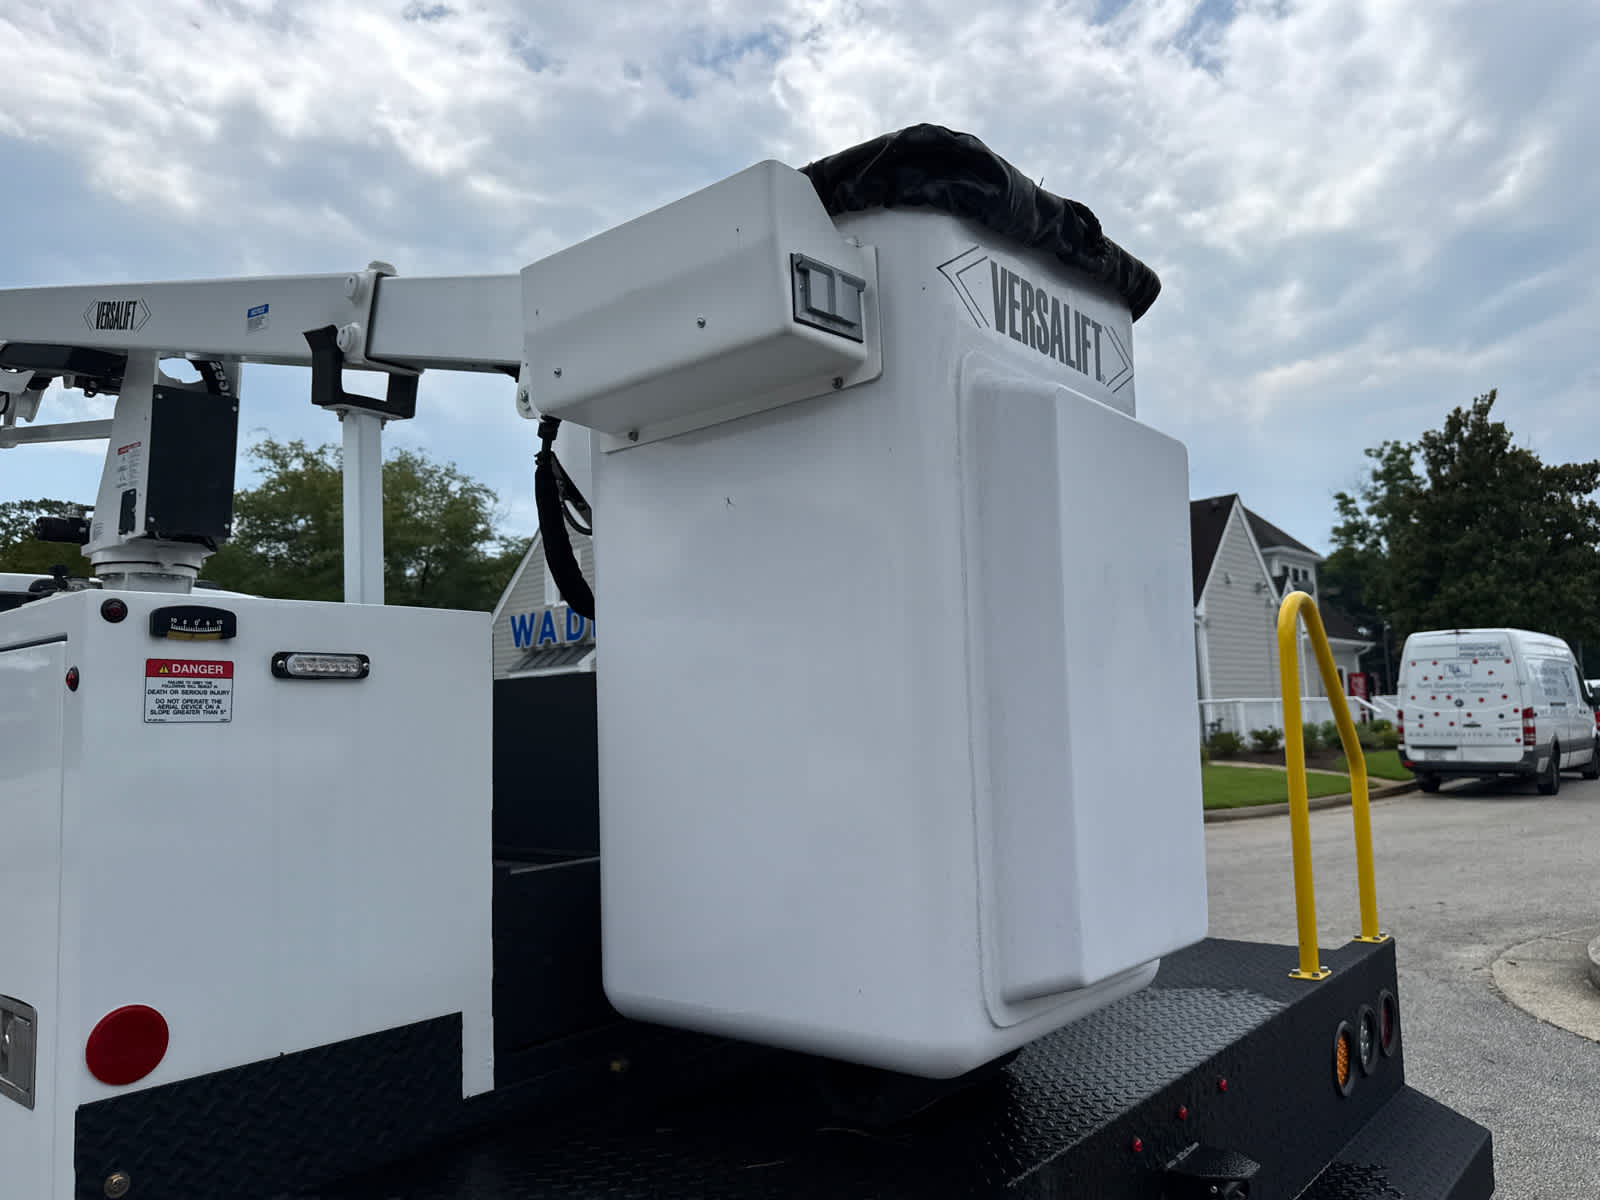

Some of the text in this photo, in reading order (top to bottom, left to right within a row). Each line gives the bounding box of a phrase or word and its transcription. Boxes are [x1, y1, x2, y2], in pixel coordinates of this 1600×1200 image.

[96, 301, 137, 330] VERSALIFT
[990, 259, 1102, 382] VERSALIFT
[510, 607, 596, 648] WAD
[172, 663, 224, 674] DANGER
